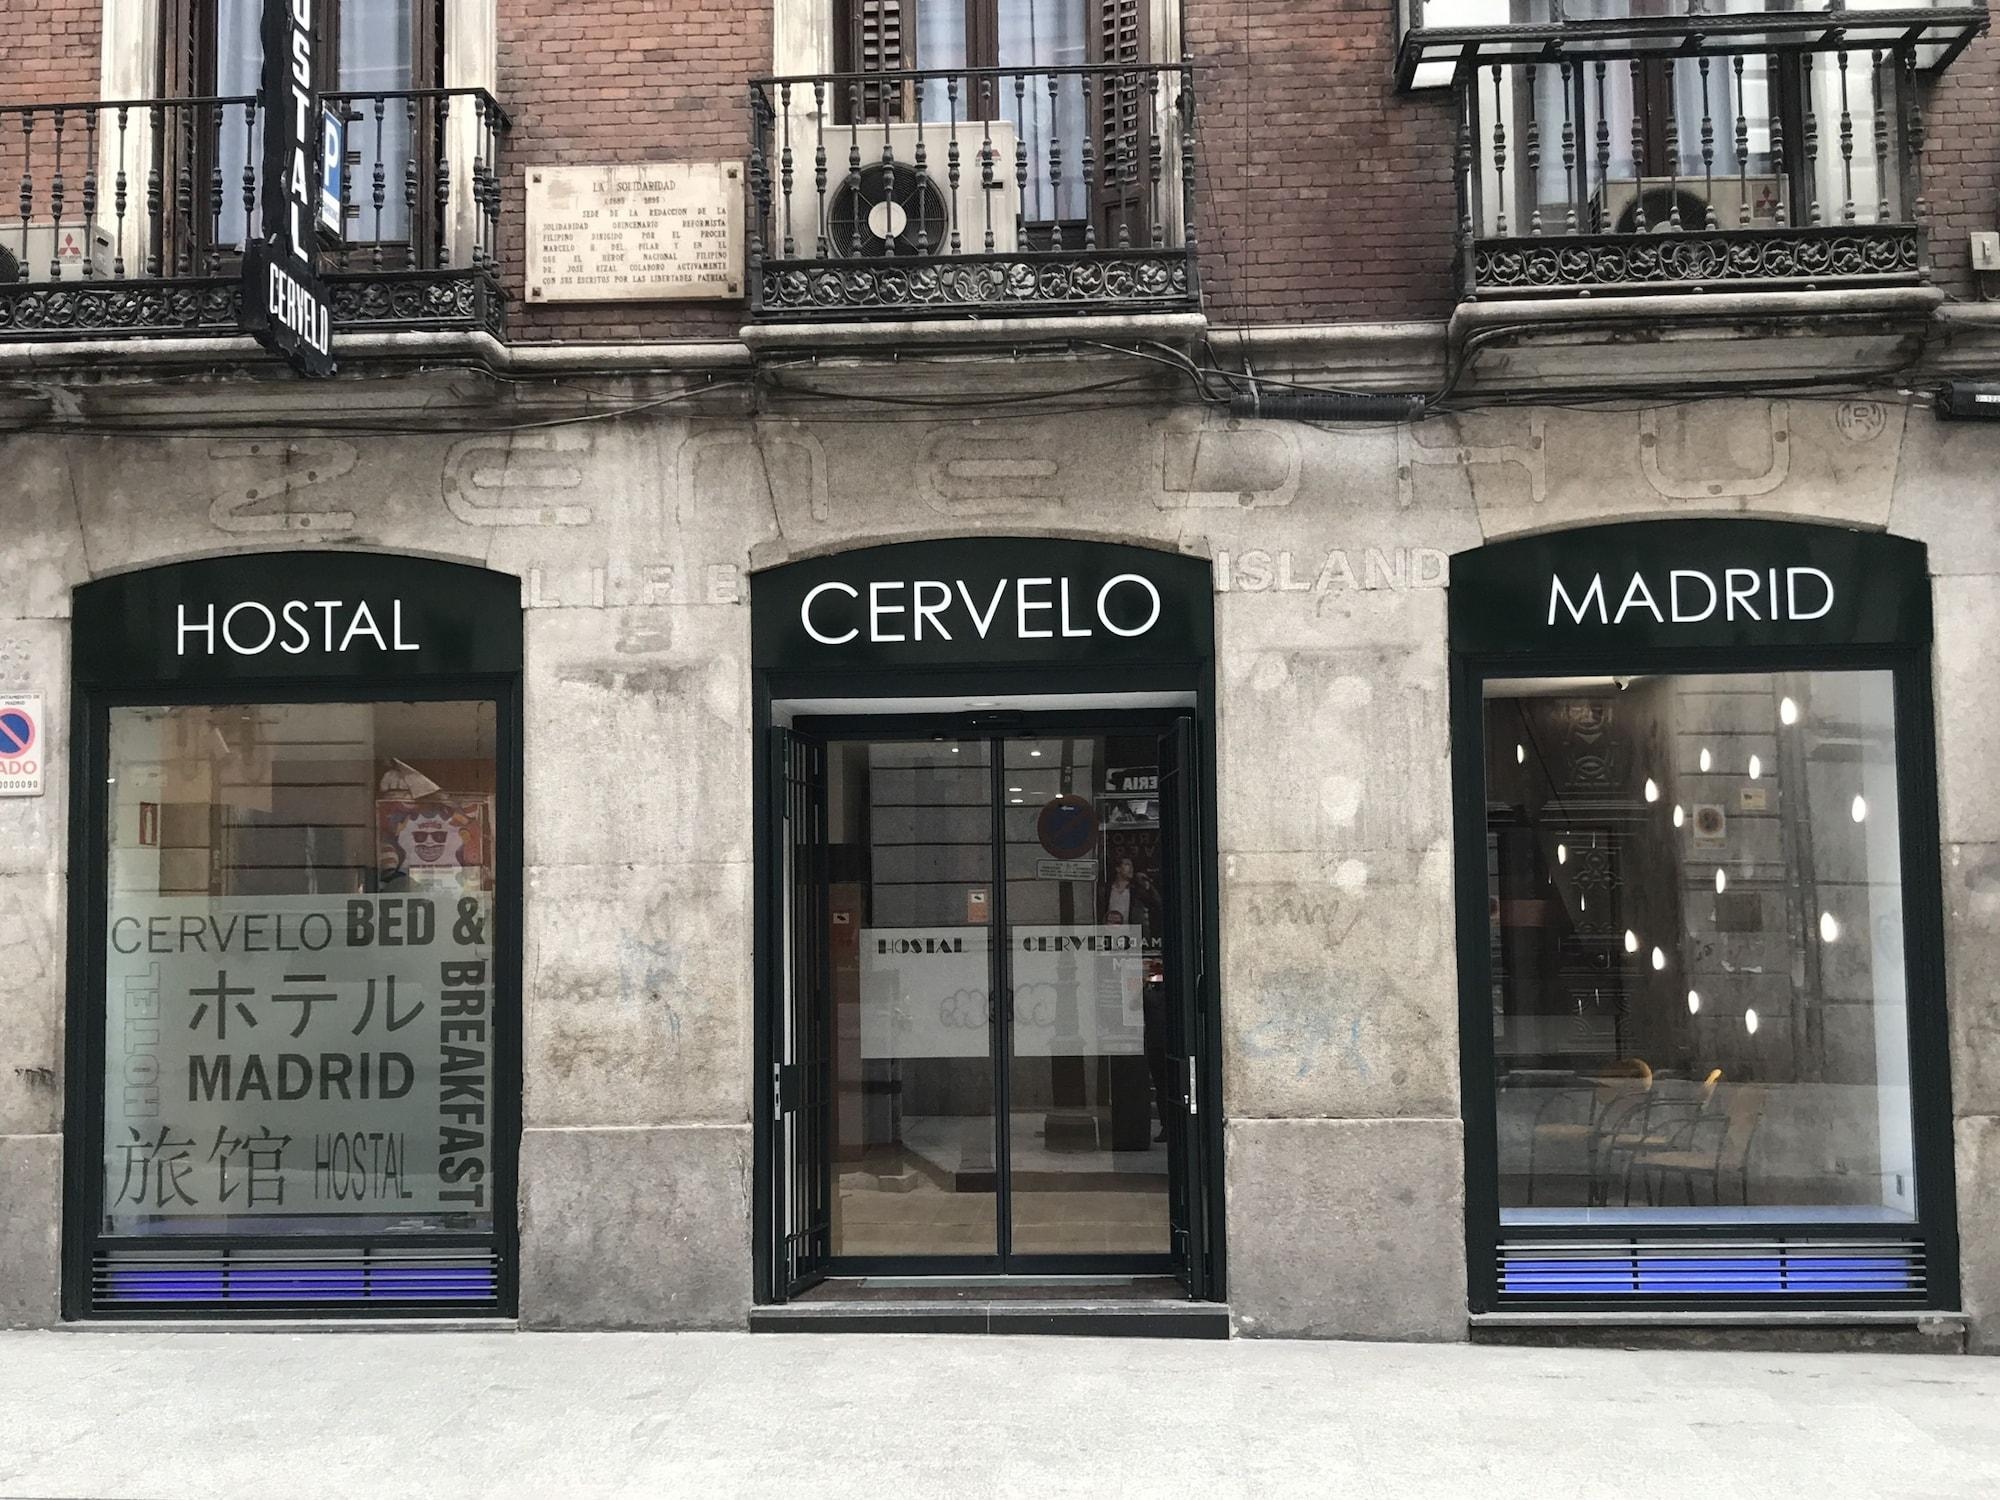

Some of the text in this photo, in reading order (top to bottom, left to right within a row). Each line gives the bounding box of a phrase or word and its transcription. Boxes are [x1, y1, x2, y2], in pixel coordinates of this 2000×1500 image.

[593, 180, 676, 192] LA SOLIDARIDAD
[543, 222, 589, 231] SOLIDARIDAD
[682, 219, 726, 228] REFORMISTA
[582, 210, 599, 218] SEDE
[610, 210, 618, 218] DE
[629, 209, 638, 217] LA
[698, 208, 706, 216] DE
[717, 207, 727, 215] LA
[543, 233, 574, 242] FILIPINO
[591, 232, 624, 240] DIRIGIDO
[642, 231, 655, 240] POR
[672, 231, 681, 239] EL
[543, 244, 576, 252] MARCELO
[611, 243, 625, 252] DEL
[639, 242, 660, 251] PILAR
[693, 241, 702, 249] EN
[718, 240, 727, 248] EL
[573, 254, 582, 262] EL
[643, 252, 678, 260] NACIONAL
[696, 252, 728, 260] FILIPINO
[542, 276, 556, 285] CON
[577, 276, 610, 284] ESCRITOS
[614, 275, 628, 284] POR
[632, 275, 646, 283] LAS
[650, 274, 692, 283] LIBERTADES
[698, 273, 728, 282] PATRIAS
[596, 264, 617, 272] RIZAL
[677, 262, 727, 271] ACTIVAMENTE
[269, 262, 329, 356] CERVELO
[1217, 549, 1449, 592] ISLAND
[801, 573, 1161, 645] CERVELO
[1547, 567, 1834, 626] MADRID
[177, 599, 420, 655] HOSTAL
[111, 912, 332, 954] CERVELO
[346, 896, 484, 947] BED &
[878, 937, 968, 954] HOSTAL
[1022, 935, 1131, 952] CERVELO
[187, 968, 425, 1041] ホテル
[123, 961, 161, 1118] HOTEL
[187, 1051, 416, 1102] MADRID
[438, 960, 485, 1208] BREAKFAST
[113, 1124, 292, 1208] 旅馆
[314, 1131, 414, 1201] HOSTAL
